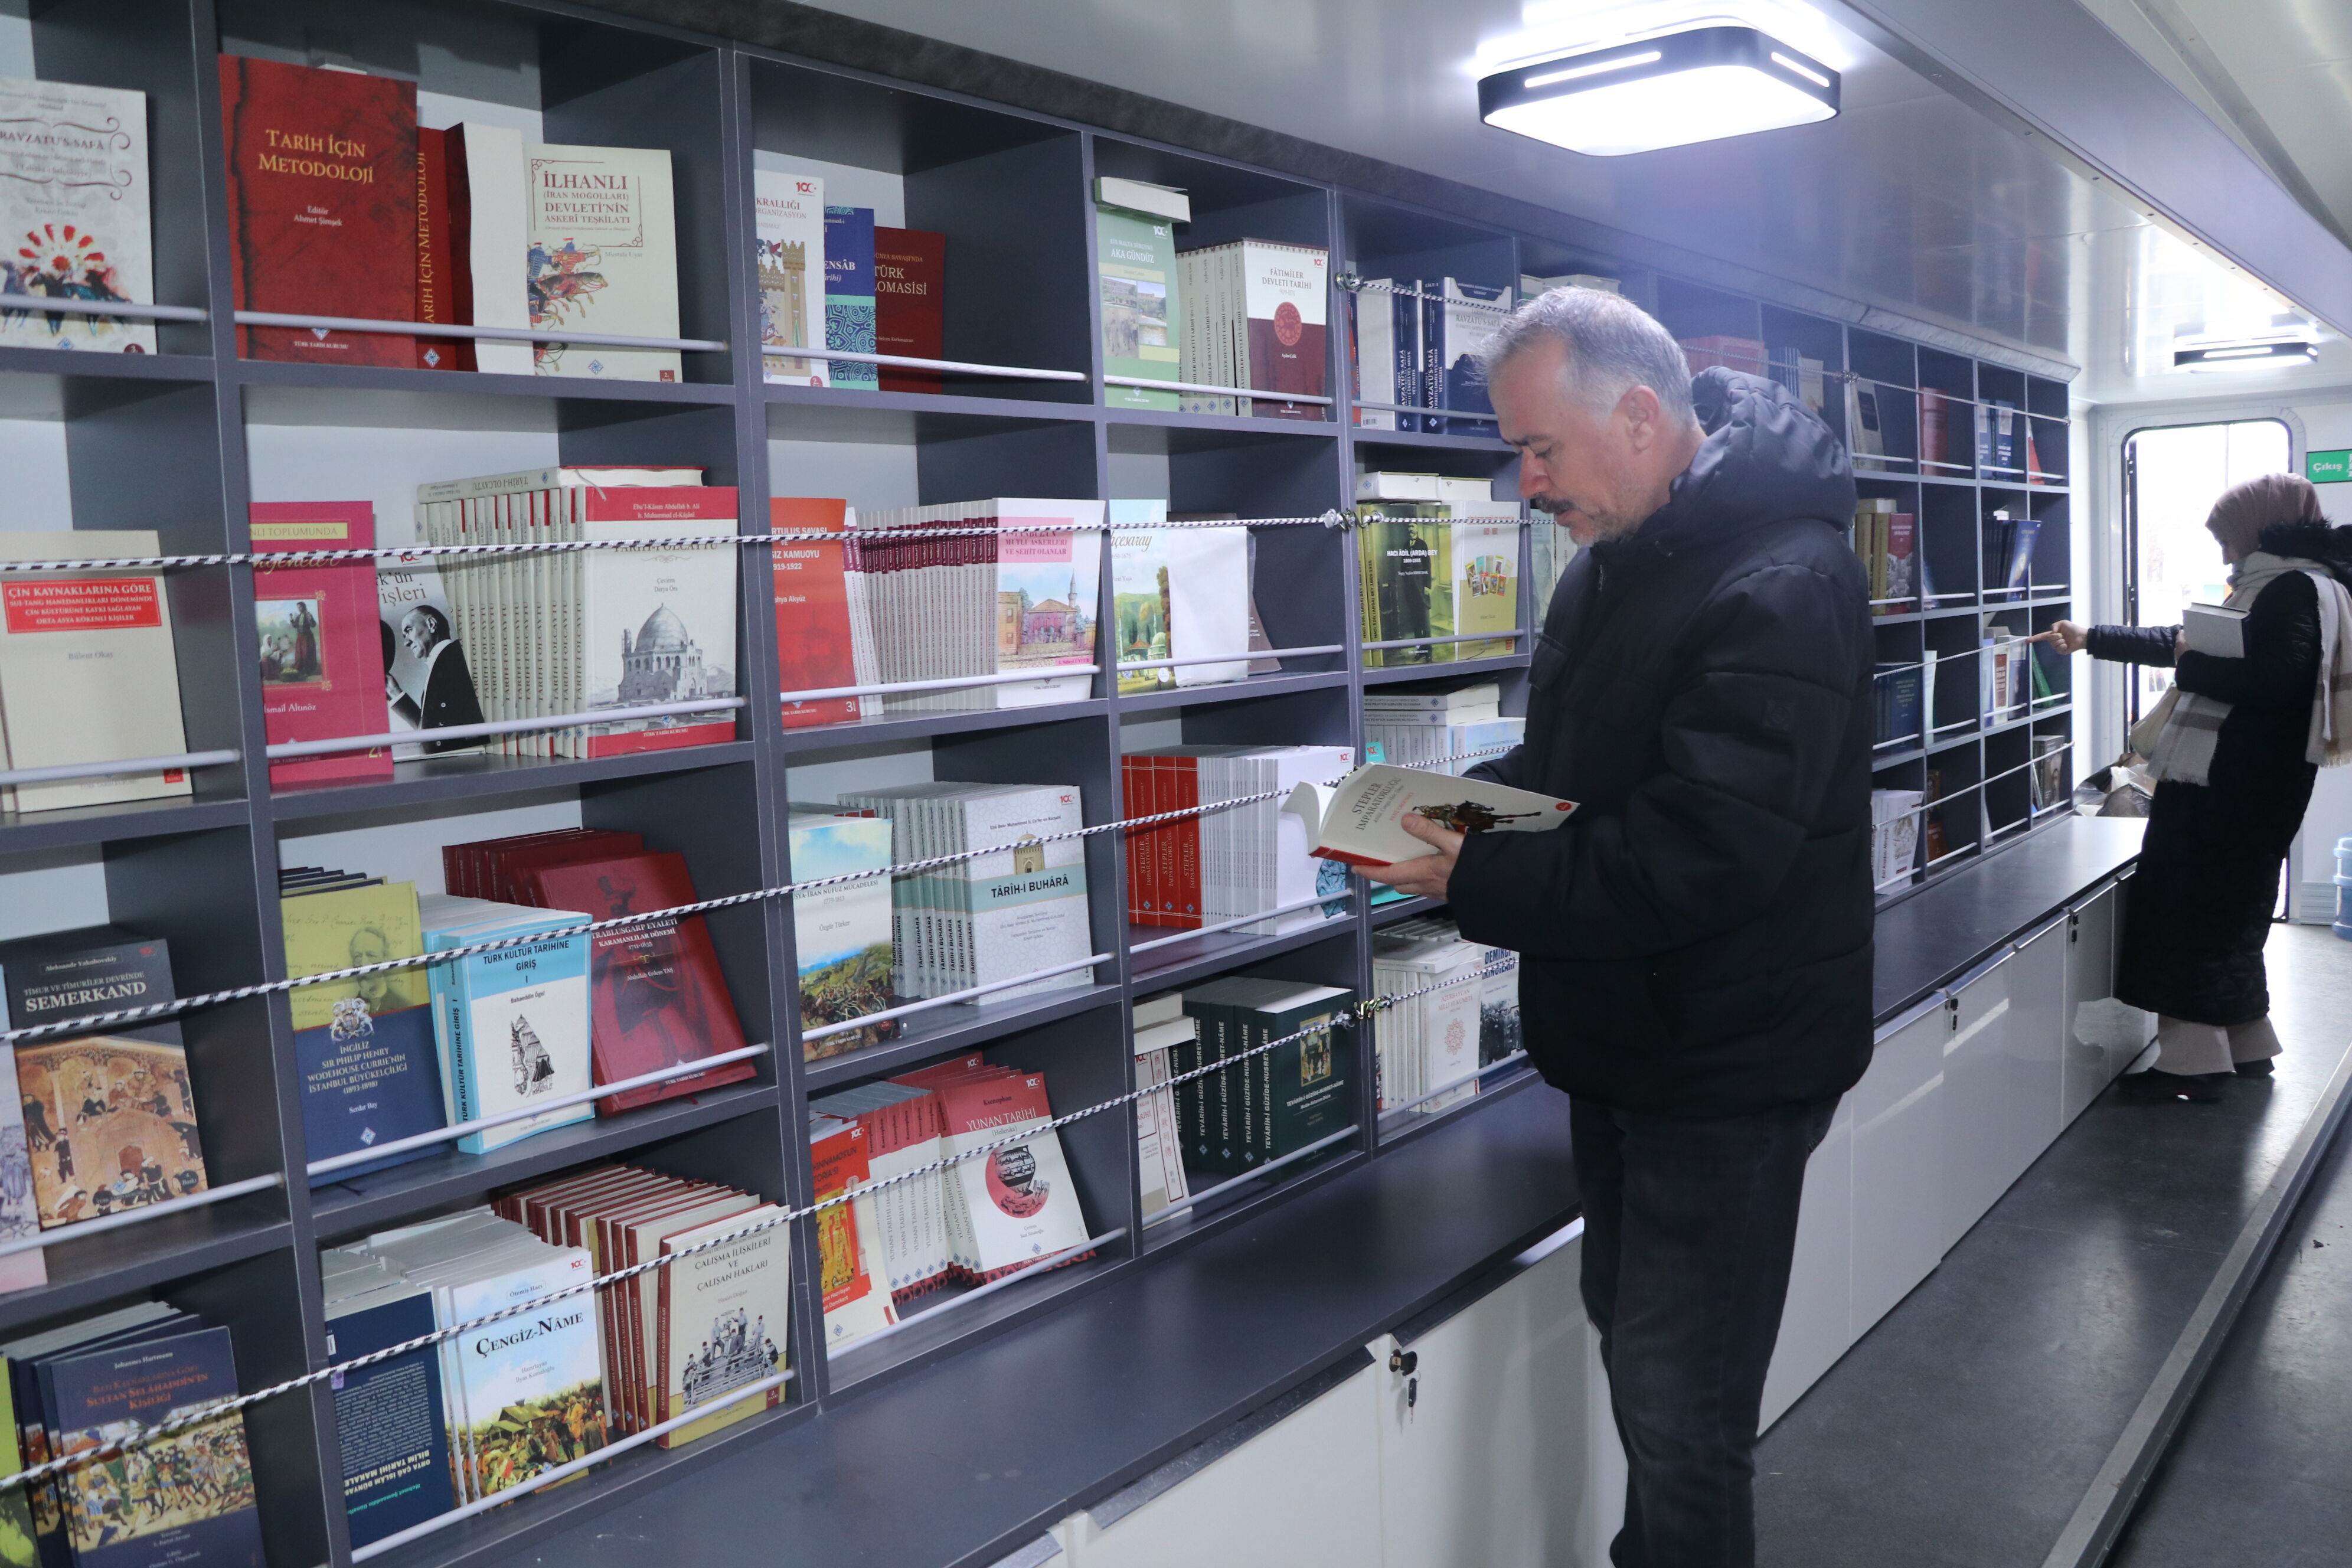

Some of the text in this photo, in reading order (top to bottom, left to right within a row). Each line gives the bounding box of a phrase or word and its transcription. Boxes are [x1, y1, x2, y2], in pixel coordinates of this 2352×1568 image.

[266, 129, 365, 158] TARİH İÇİN
[259, 153, 374, 184] METODOLOJİ
[543, 171, 628, 190] İLHANLI
[543, 190, 629, 201] (İRAN MOĞOLLARI)
[307, 205, 328, 215] Editör
[545, 201, 629, 213] DEVLETİ'NİN
[756, 209, 806, 219] RGANİZASYON
[294, 214, 342, 227] Ahmet Şimşek
[545, 214, 631, 224] ASKERÎ TEŞKİLATI
[417, 152, 435, 324] ARİH İÇİN METODOLOJİ
[1111, 249, 1155, 263] AKA GÜNDÜZ
[1262, 276, 1312, 289] DEVLETİ TARİHİ
[2313, 463, 2343, 472] Çıkış
[269, 527, 338, 537] TOPLUMUNDA
[783, 550, 819, 558] KAMUOYU
[8, 583, 152, 598] ÇİN KAYNAKLARINA GÖRE
[289, 703, 316, 712] Altınöz
[1351, 782, 1383, 815] STEPLER
[991, 874, 1070, 898] TÂRÎH-İ BUHÂRÂ
[592, 917, 678, 940] TRABLUSGARP EYALETİ
[834, 920, 851, 930] Türker
[599, 927, 676, 948] KARAMANLILAR DÖNEMİ
[483, 939, 570, 965] TÜRK KÜLTÜR TARİHİNE
[516, 958, 537, 972] GİRİŞ
[663, 967, 674, 975] TAŞ
[24, 971, 145, 997] TİMUR VE TİMURİLER DEVRİNDE
[26, 981, 146, 1012] SEMERKAND
[339, 1041, 370, 1055] İNGİLİZ
[322, 1047, 390, 1069] SIR PHILIP HENRY
[308, 1064, 360, 1082] WODEHOUSE
[309, 1062, 408, 1093] İSTANBUL BÜYÜKELÇİLİĞİ
[349, 1103, 367, 1115] Serdar
[966, 1106, 1037, 1131] YUNAN TARİHİ
[694, 1252, 731, 1270] ÇALIŞMA
[732, 1236, 771, 1258] İLİŞKİLERİ
[728, 1259, 739, 1269] VE
[697, 1259, 769, 1292] ÇALIŞAN HAKLARI
[509, 1287, 530, 1298] Ötemiş
[476, 1312, 584, 1358] ÇENGİZ-NÂME
[114, 1351, 174, 1370] Johannes Hartmann
[344, 1449, 430, 1487] BİLİM TARİHİ MAKALE
[413, 1458, 431, 1468] ORTA
[397, 1466, 411, 1478] ÇAĞ
[344, 1480, 373, 1497] DÜNYAS
